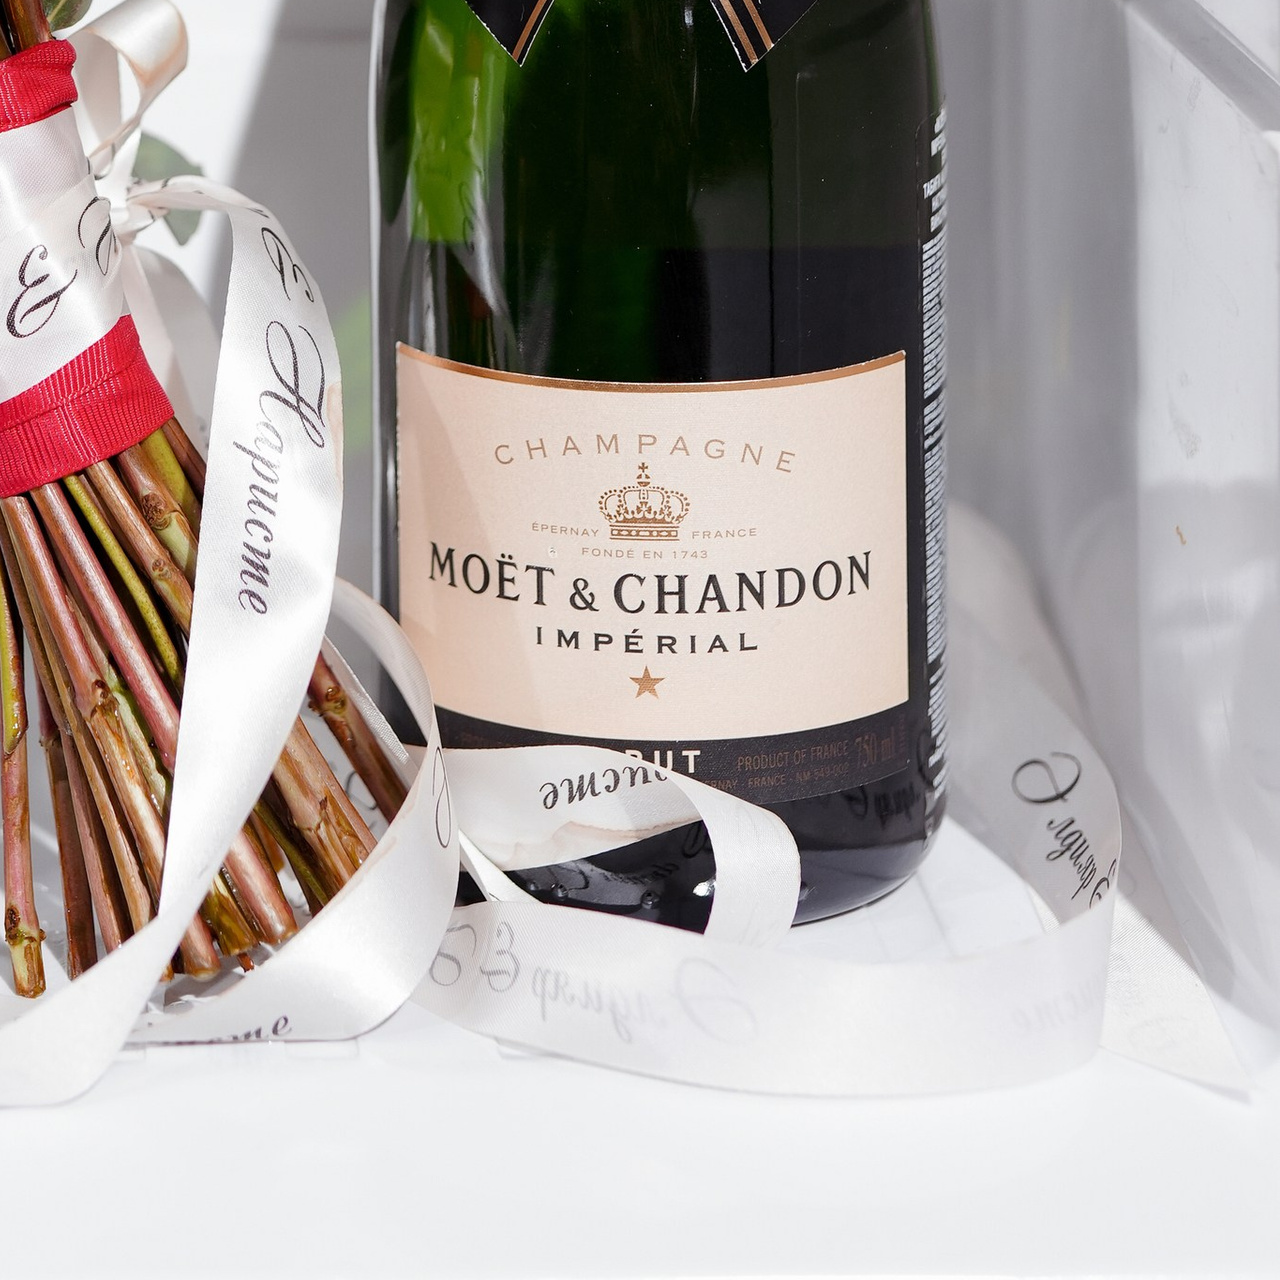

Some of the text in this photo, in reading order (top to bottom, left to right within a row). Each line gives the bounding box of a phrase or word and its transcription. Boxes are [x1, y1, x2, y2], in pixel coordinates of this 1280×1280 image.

[261, 227, 315, 304] &
[7, 244, 78, 338] &
[493, 433, 797, 474] CHAMPAGNE
[531, 520, 758, 540] ÉPERNAY FRANCE
[581, 546, 709, 559] FONDÉ EN 1743
[428, 541, 873, 615] MOËT & CHANDON
[536, 625, 759, 654] IMPÉRIAL
[736, 740, 849, 772] PRODUCT OF FRANCE
[748, 774, 787, 789] FRANCE
